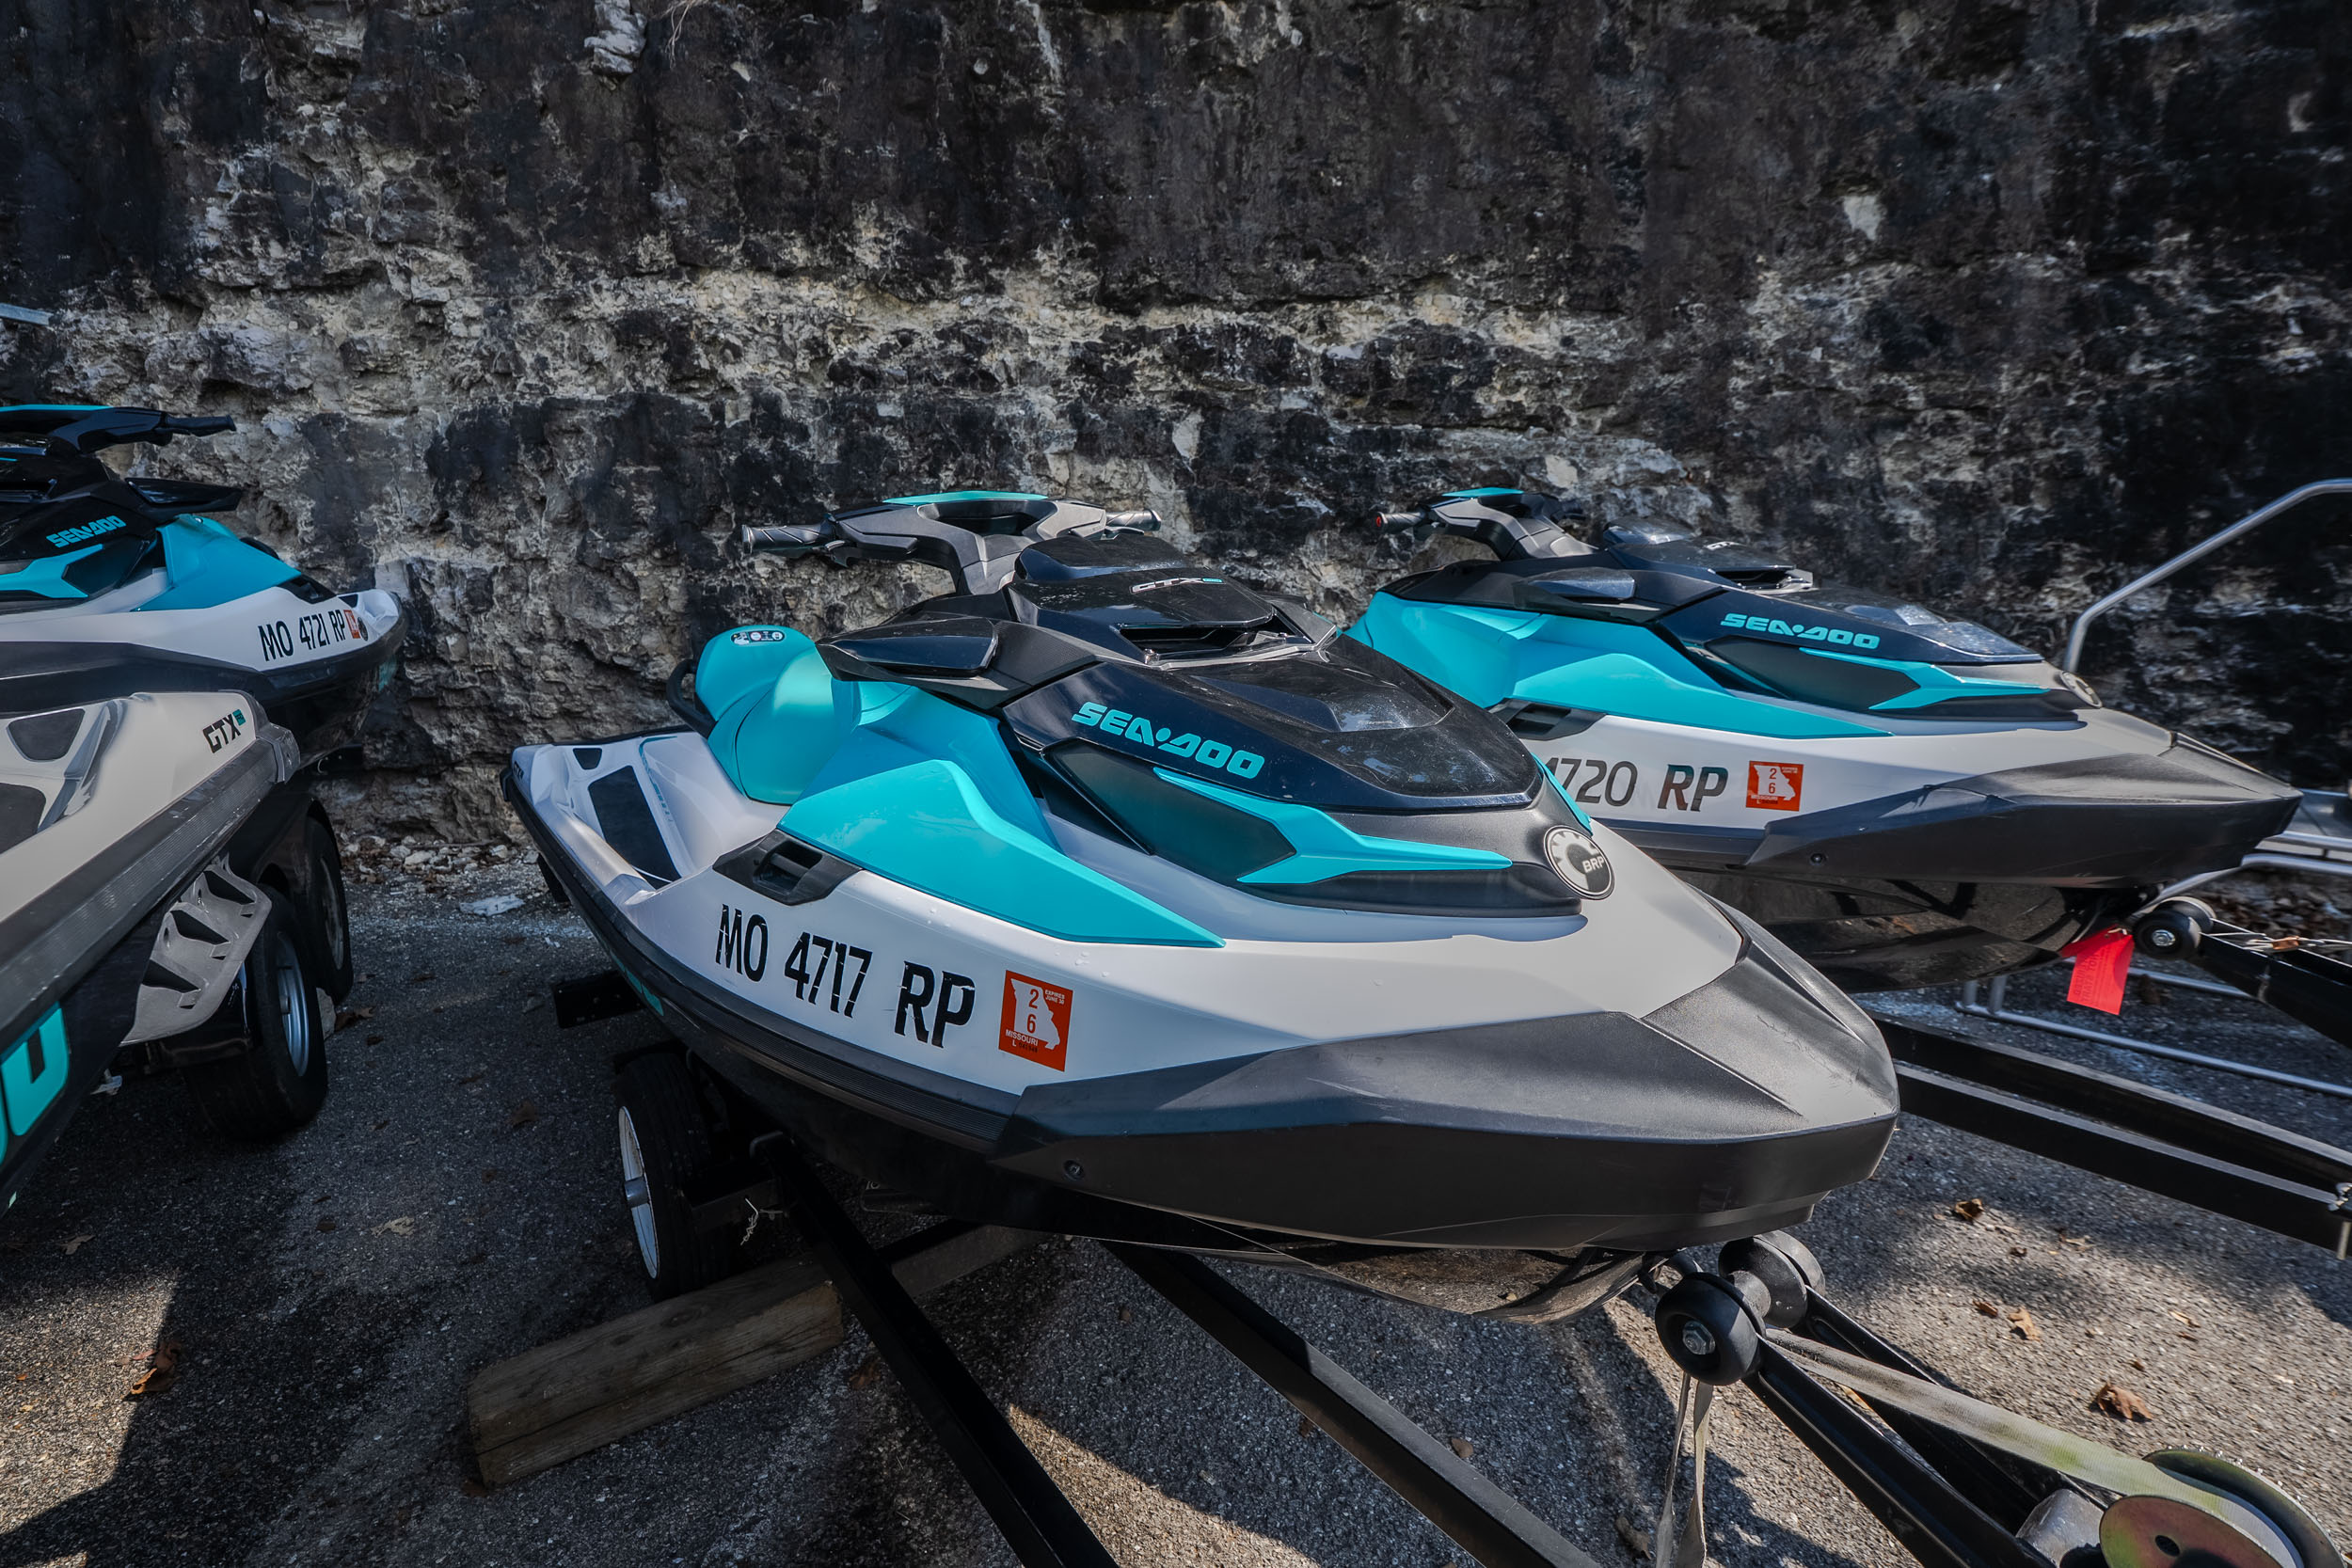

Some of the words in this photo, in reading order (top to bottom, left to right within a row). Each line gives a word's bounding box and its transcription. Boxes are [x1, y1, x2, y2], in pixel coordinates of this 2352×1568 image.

[257, 620, 294, 662] MO
[298, 613, 331, 651] 4721
[327, 609, 346, 642] RP
[202, 713, 242, 753] GTX
[1769, 768, 1777, 779] 2
[1657, 764, 1729, 812] RP
[1769, 782, 1776, 794] 6
[1582, 855, 1605, 873] BRP
[715, 903, 769, 983] MO
[784, 931, 873, 1019] 4717
[894, 960, 976, 1049] RP
[1028, 989, 1039, 1009] 2
[1026, 1013, 1037, 1034] 6
[1005, 1029, 1039, 1047] MISSOURI
